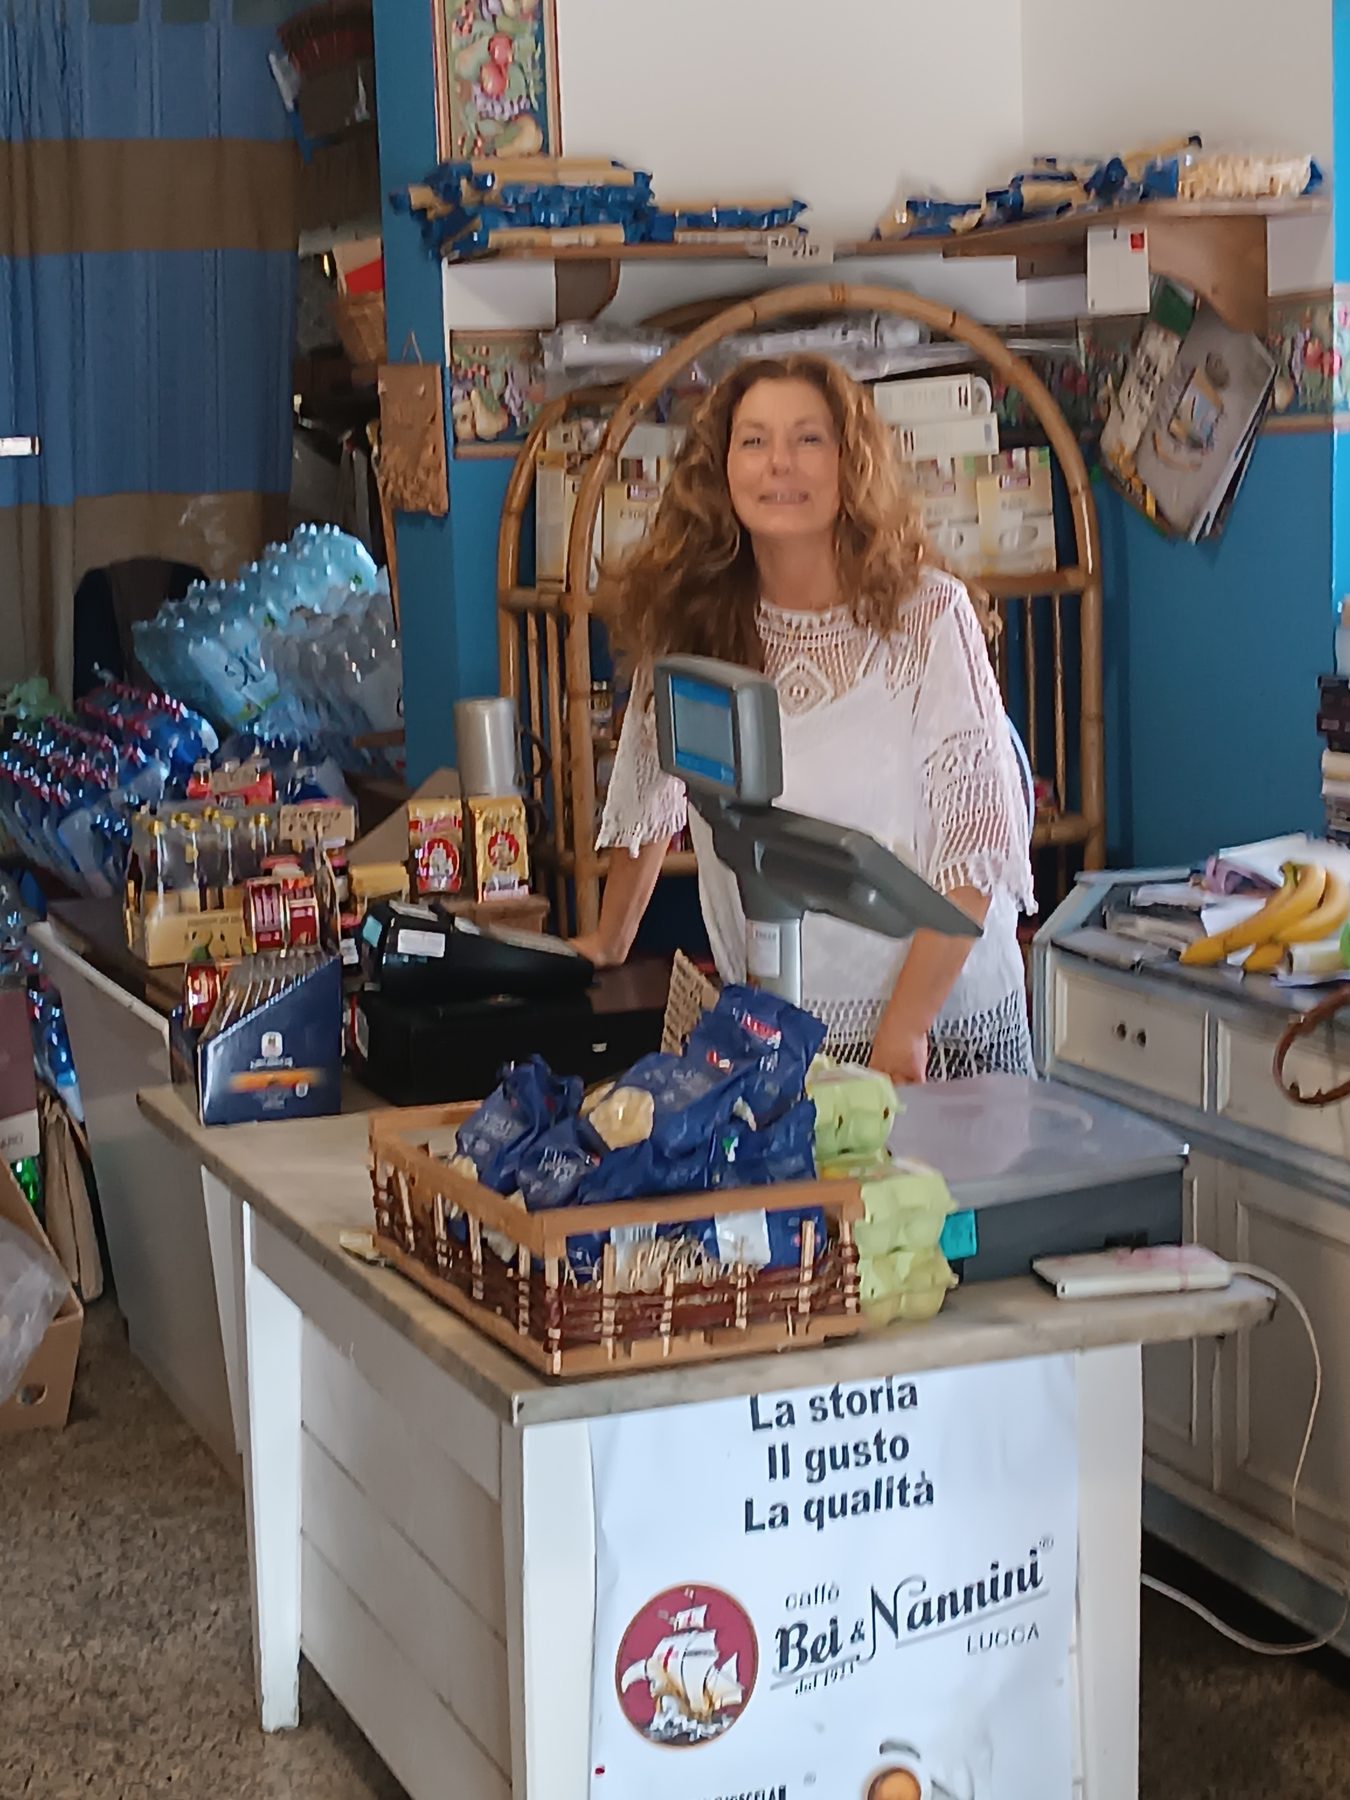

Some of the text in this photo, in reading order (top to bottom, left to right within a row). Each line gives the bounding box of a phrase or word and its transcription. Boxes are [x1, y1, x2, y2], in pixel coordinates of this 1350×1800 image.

[750, 1376, 918, 1432] La storia
[768, 1427, 910, 1484] Il gusto
[744, 1470, 935, 1534] La qualità
[774, 1547, 1045, 1676] Bei & Nannini
[966, 1621, 1040, 1655] LUCCA
